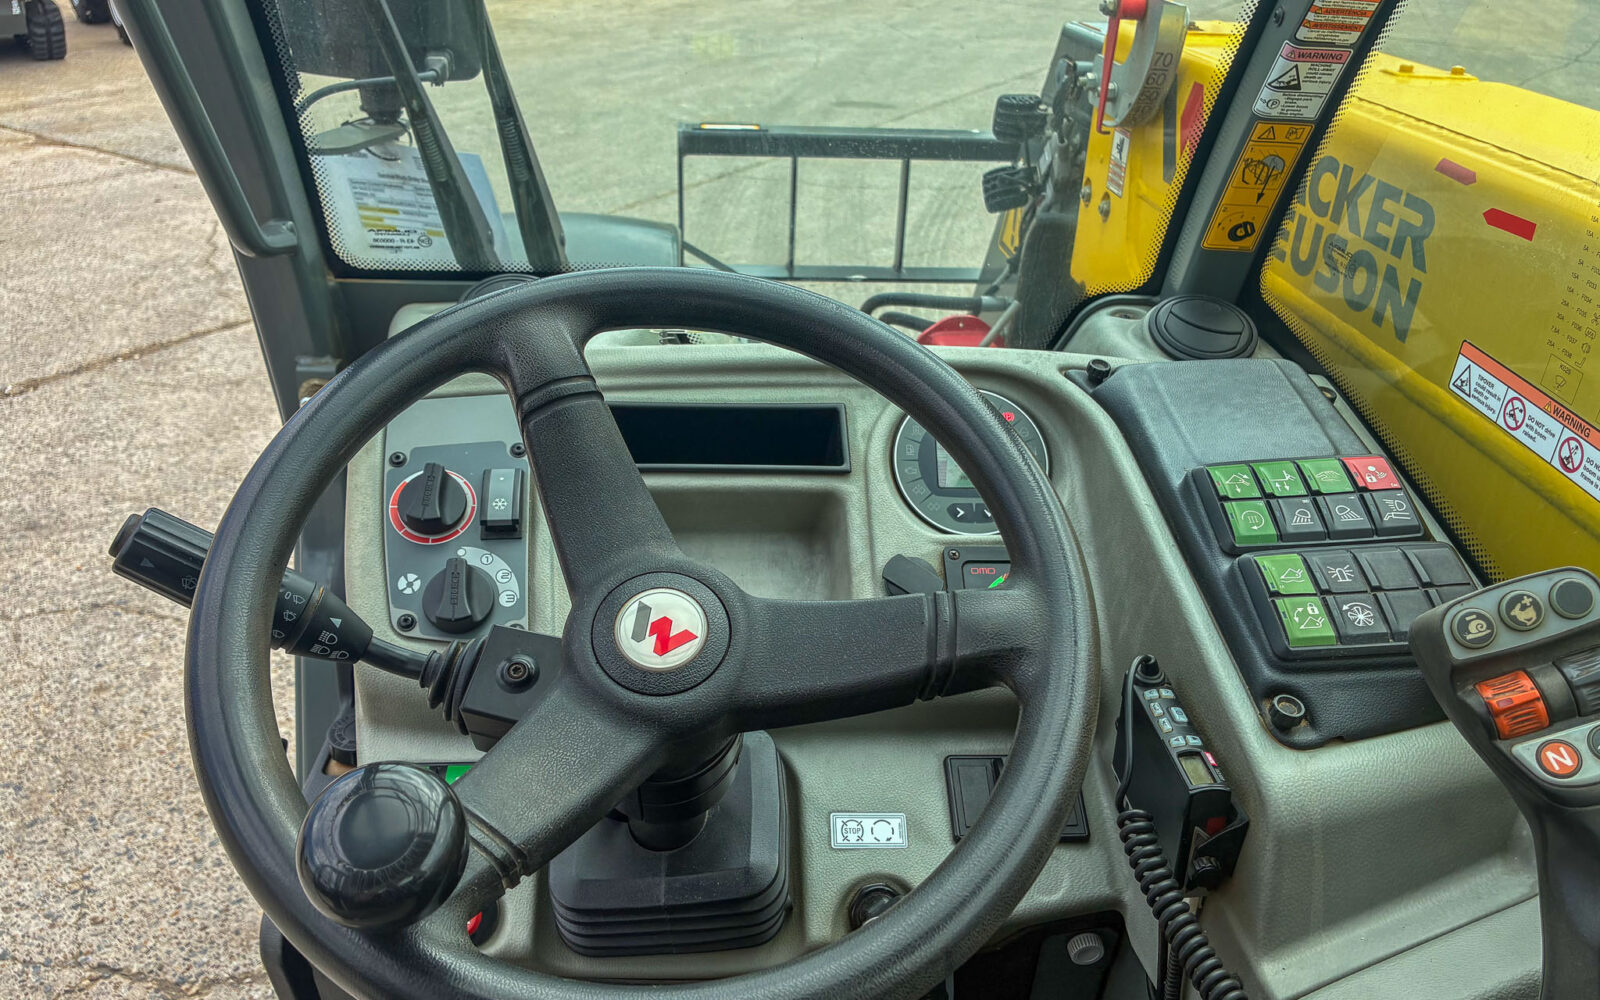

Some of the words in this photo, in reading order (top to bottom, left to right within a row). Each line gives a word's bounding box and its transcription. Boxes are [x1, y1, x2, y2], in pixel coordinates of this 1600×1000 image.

[1153, 51, 1174, 68] 70
[1298, 51, 1343, 60] WARNING
[1145, 72, 1167, 87] 60
[1297, 155, 1436, 274] CKER
[1473, 386, 1484, 397] death
[1475, 381, 1487, 391] could
[1485, 387, 1498, 400] result
[1527, 414, 1535, 424] DO
[1535, 418, 1545, 430] NOT
[1544, 426, 1556, 438] drive
[1552, 404, 1591, 438] WARNING
[1525, 422, 1535, 433] with
[1534, 428, 1547, 441] boom
[1585, 456, 1595, 466] DO
[1579, 471, 1594, 486] frame
[1582, 464, 1596, 478] boom
[500, 571, 510, 580] 2
[505, 593, 516, 603] 3
[1545, 746, 1574, 771] N
[844, 827, 861, 835] STOP
